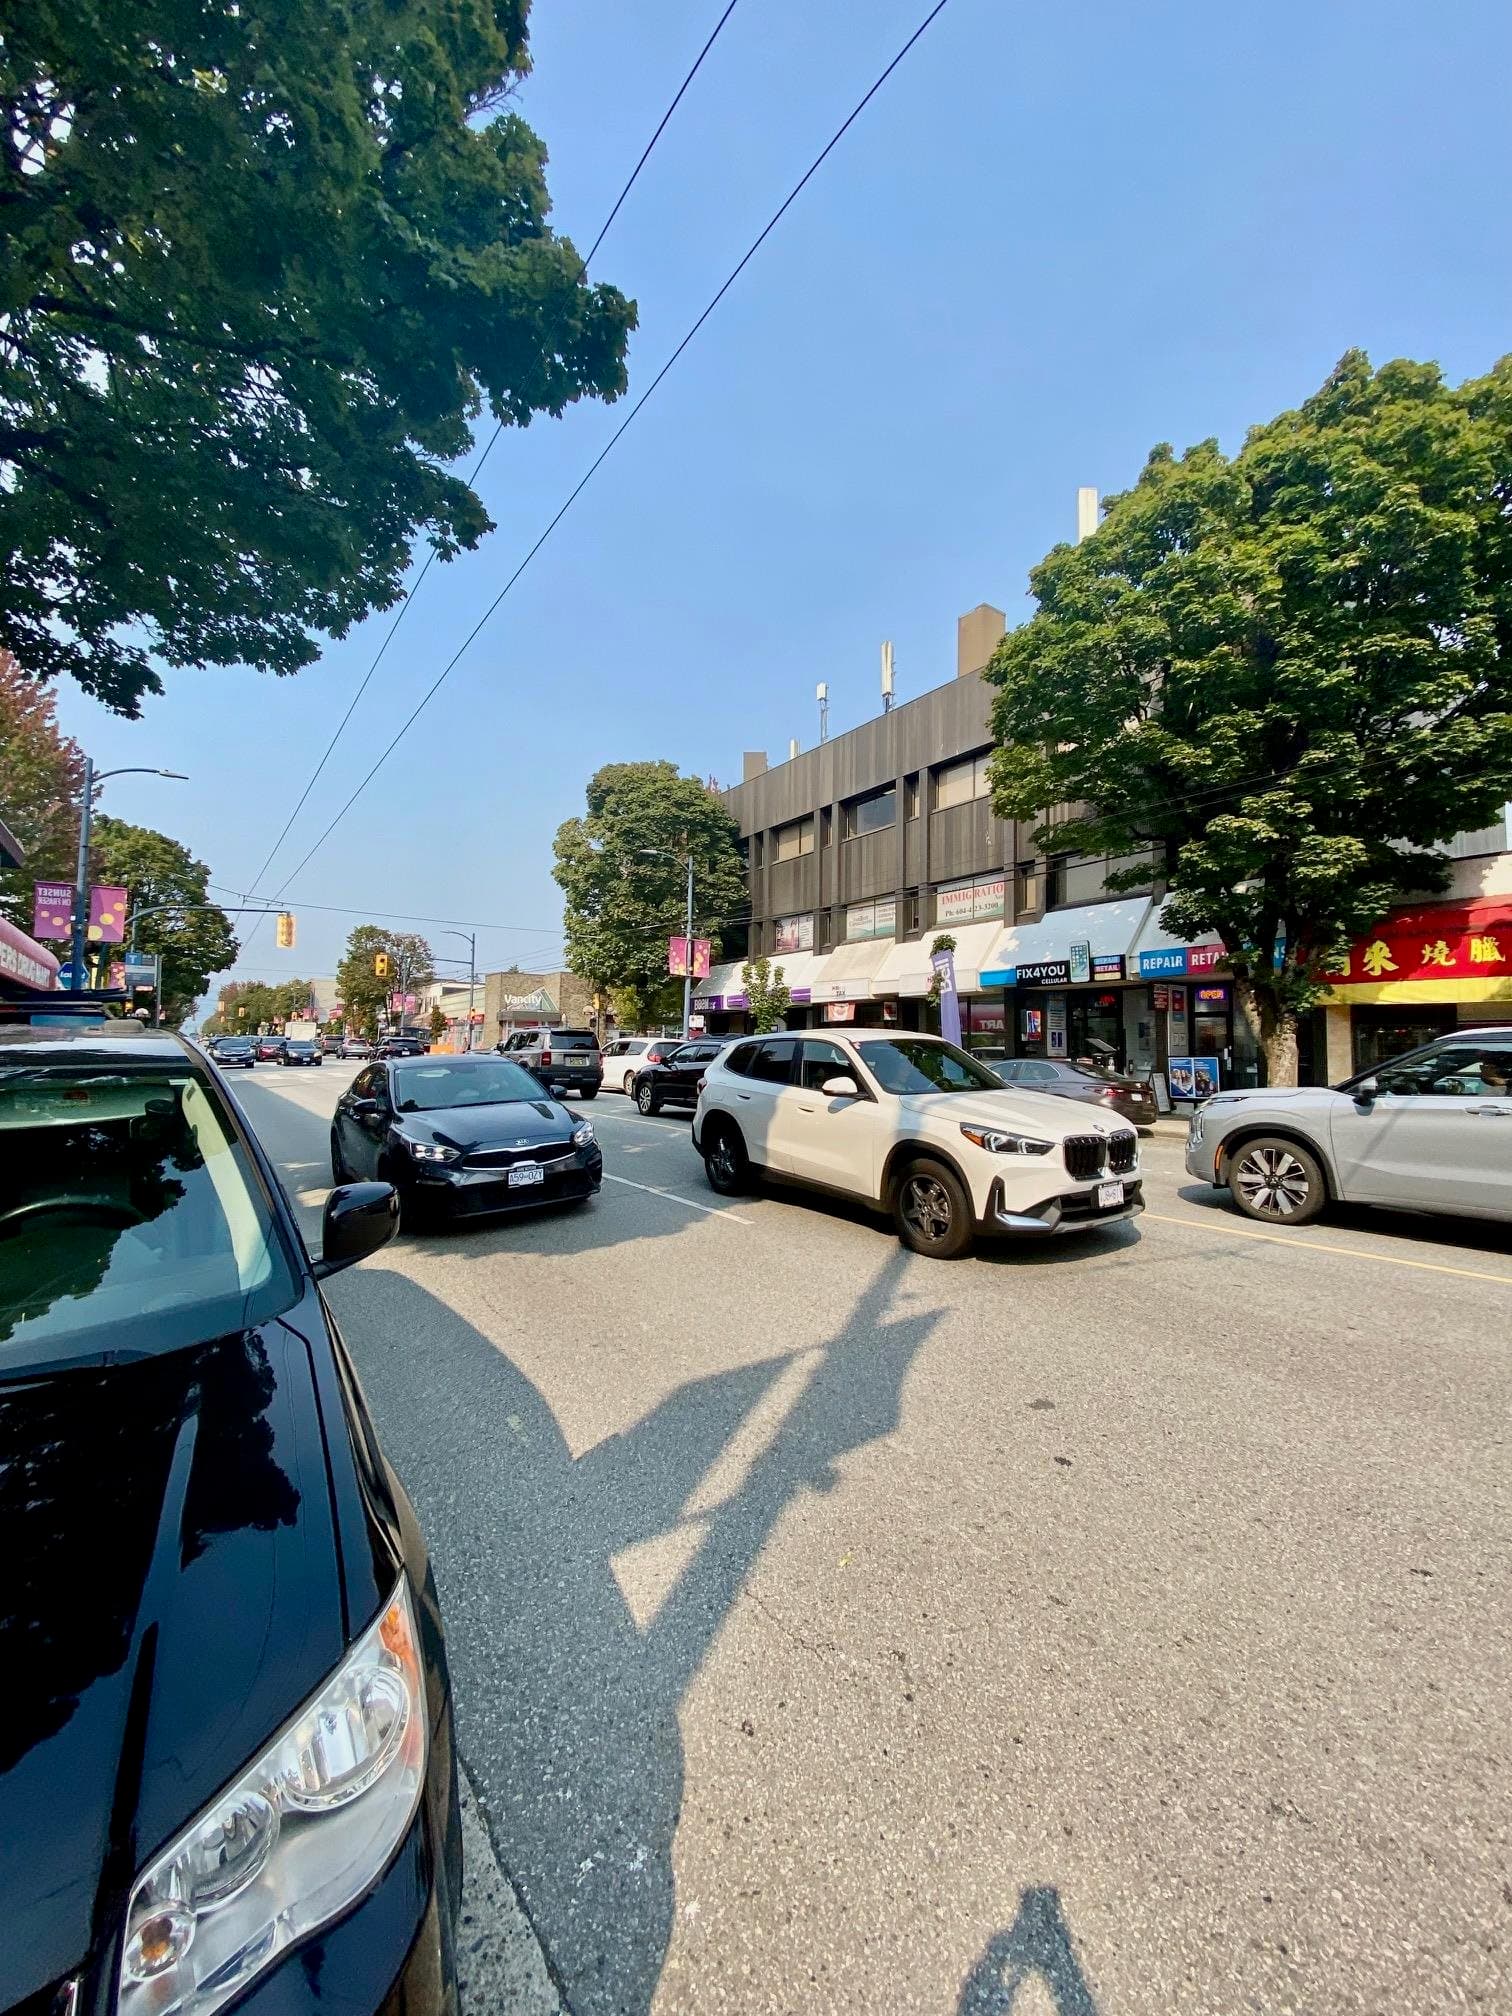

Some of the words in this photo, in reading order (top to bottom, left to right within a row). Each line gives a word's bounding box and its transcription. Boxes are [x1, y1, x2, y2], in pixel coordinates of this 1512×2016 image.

[1143, 955, 1183, 970] REPAIR
[1191, 950, 1229, 966] RETA
[1016, 965, 1065, 979] FIX4YOU
[1042, 977, 1068, 985] CELLULAR
[504, 994, 542, 1007] Vancity
